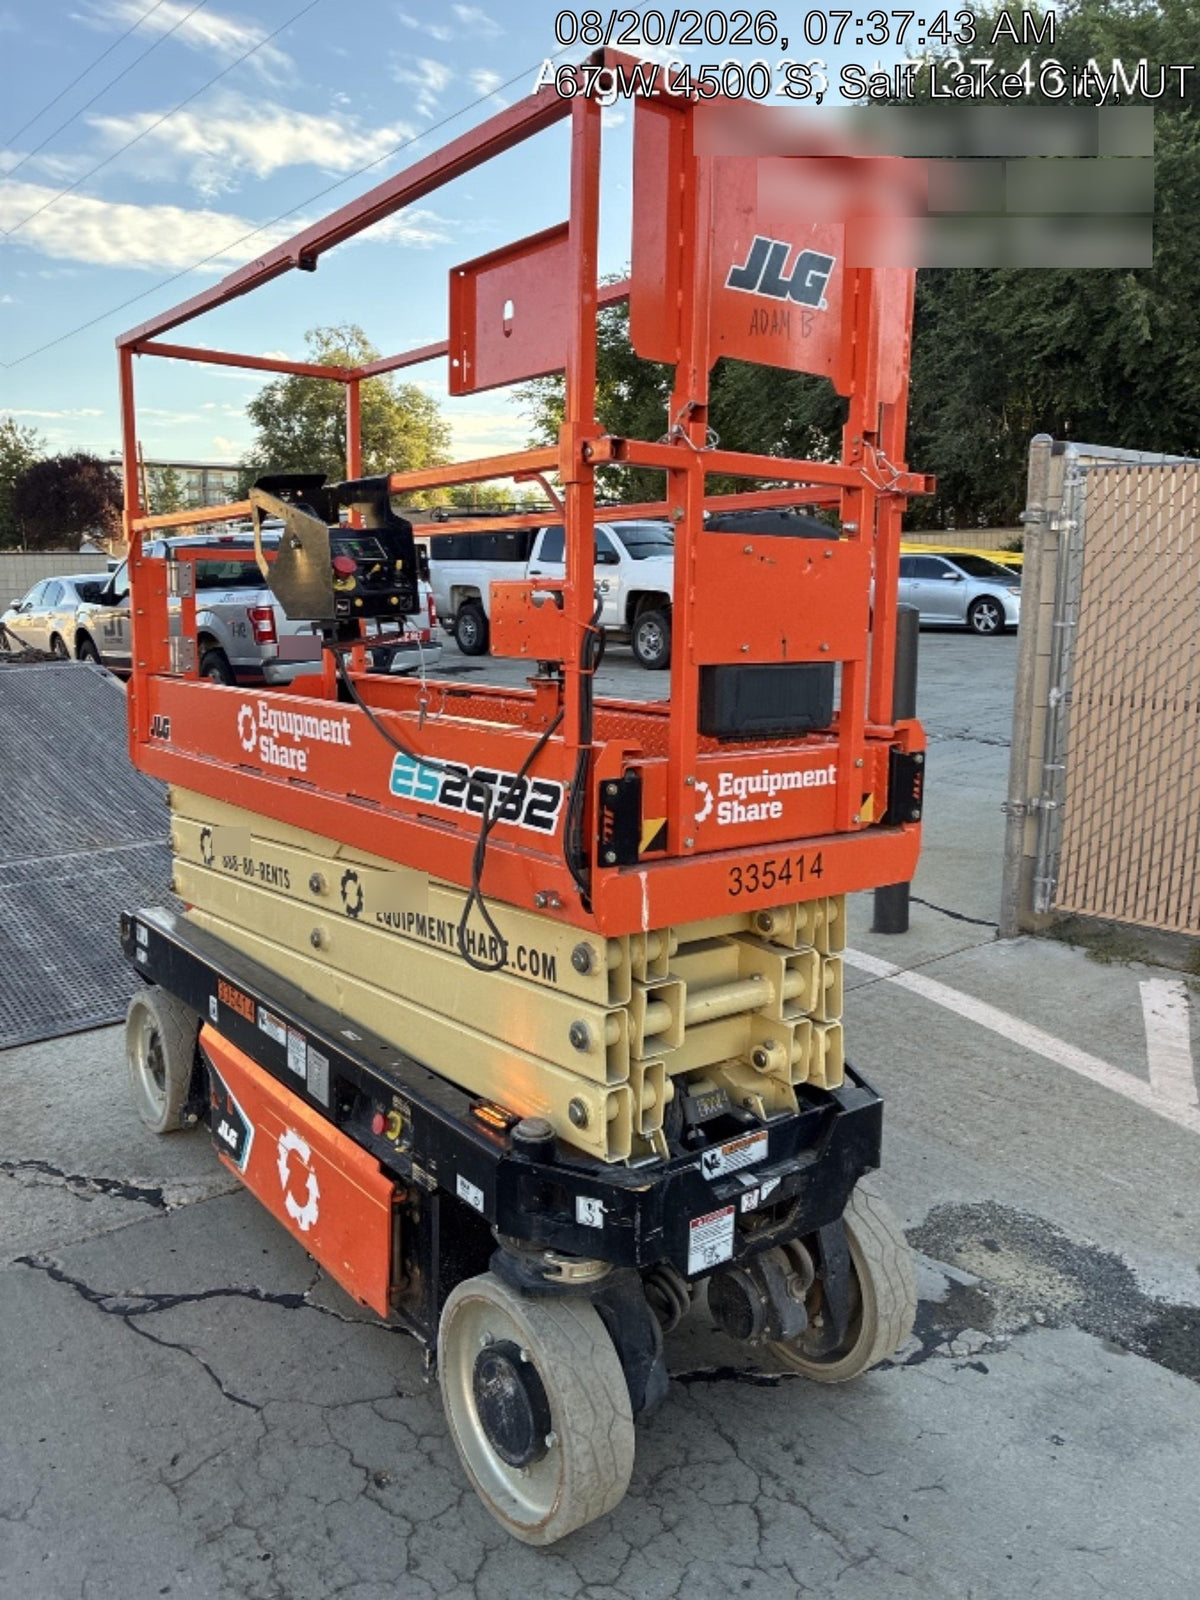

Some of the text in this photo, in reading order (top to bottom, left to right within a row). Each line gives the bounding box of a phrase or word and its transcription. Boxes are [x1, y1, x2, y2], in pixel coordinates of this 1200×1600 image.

[724, 234, 837, 310] JLG
[748, 308, 816, 340] ADAM B
[150, 713, 171, 742] JLG
[257, 700, 352, 747] Equipment
[259, 734, 309, 772] Share
[717, 764, 837, 799] Equipment
[716, 798, 784, 825] Share
[728, 851, 824, 897] 335414
[217, 1119, 239, 1149] JLG
